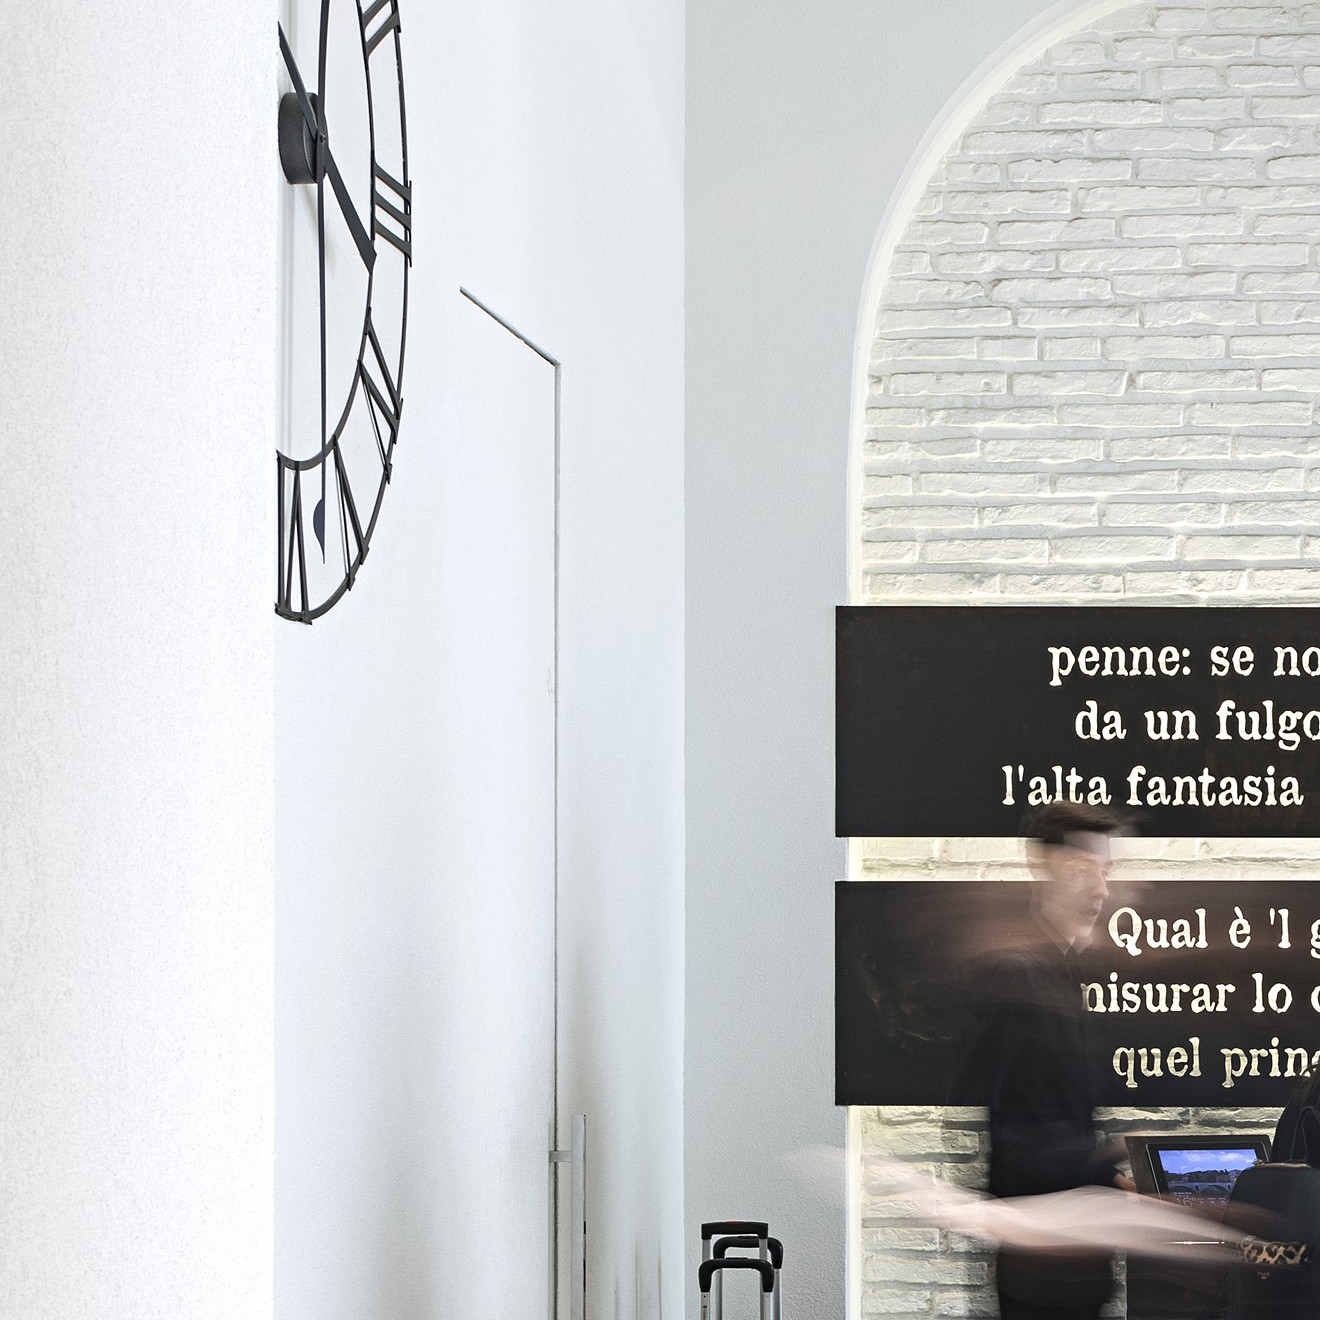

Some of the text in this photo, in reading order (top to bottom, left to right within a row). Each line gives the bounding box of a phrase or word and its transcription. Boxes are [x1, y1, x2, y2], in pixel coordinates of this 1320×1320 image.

[1047, 645, 1191, 687] penne:
[1210, 645, 1255, 677] se
[1074, 699, 1127, 741] da
[1143, 709, 1200, 741] un
[1001, 764, 1113, 807] l'alta
[1125, 764, 1305, 807] fantasia
[1107, 906, 1209, 957] Qual
[1228, 906, 1252, 949] è
[1251, 972, 1293, 1014] lo
[1112, 1036, 1202, 1089] quel
